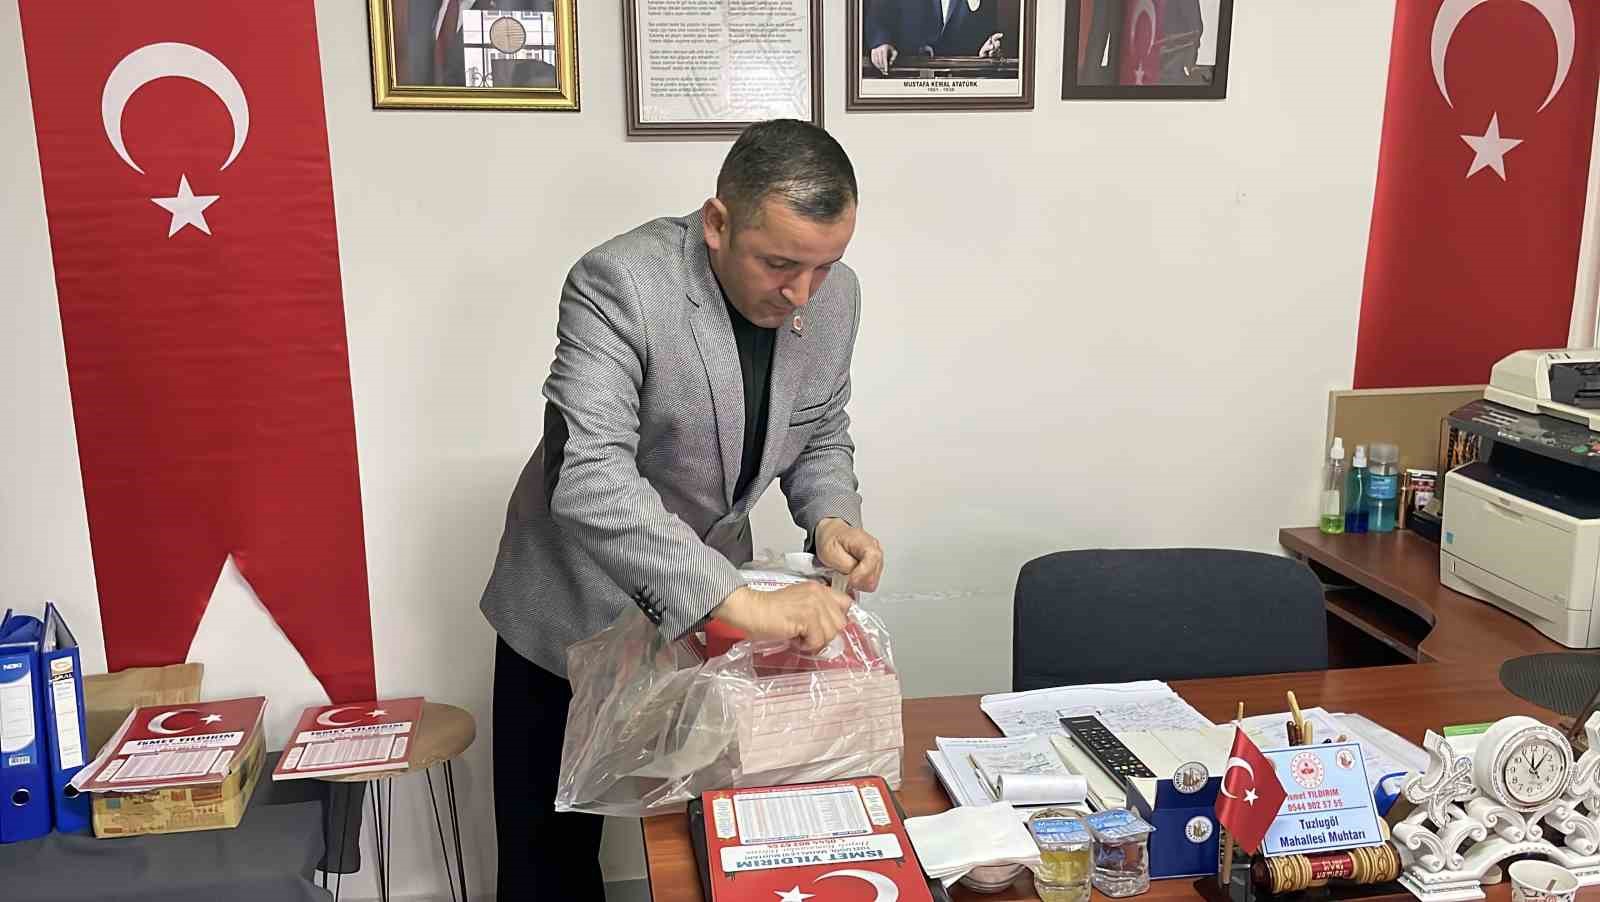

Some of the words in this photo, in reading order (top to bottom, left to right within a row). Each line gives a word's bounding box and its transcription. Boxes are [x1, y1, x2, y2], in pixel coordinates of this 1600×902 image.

[951, 80, 978, 88] ATATÜRK
[1307, 788, 1340, 798] YILDIRIM
[1288, 803, 1306, 811] 0544
[1307, 801, 1320, 809] 902
[1299, 815, 1340, 830] Tuzlugöl
[1280, 832, 1327, 848] Mahallesi
[1328, 829, 1366, 843] Muhtarı
[830, 849, 884, 861] İSMET
[736, 855, 823, 869] YILDIRIM
